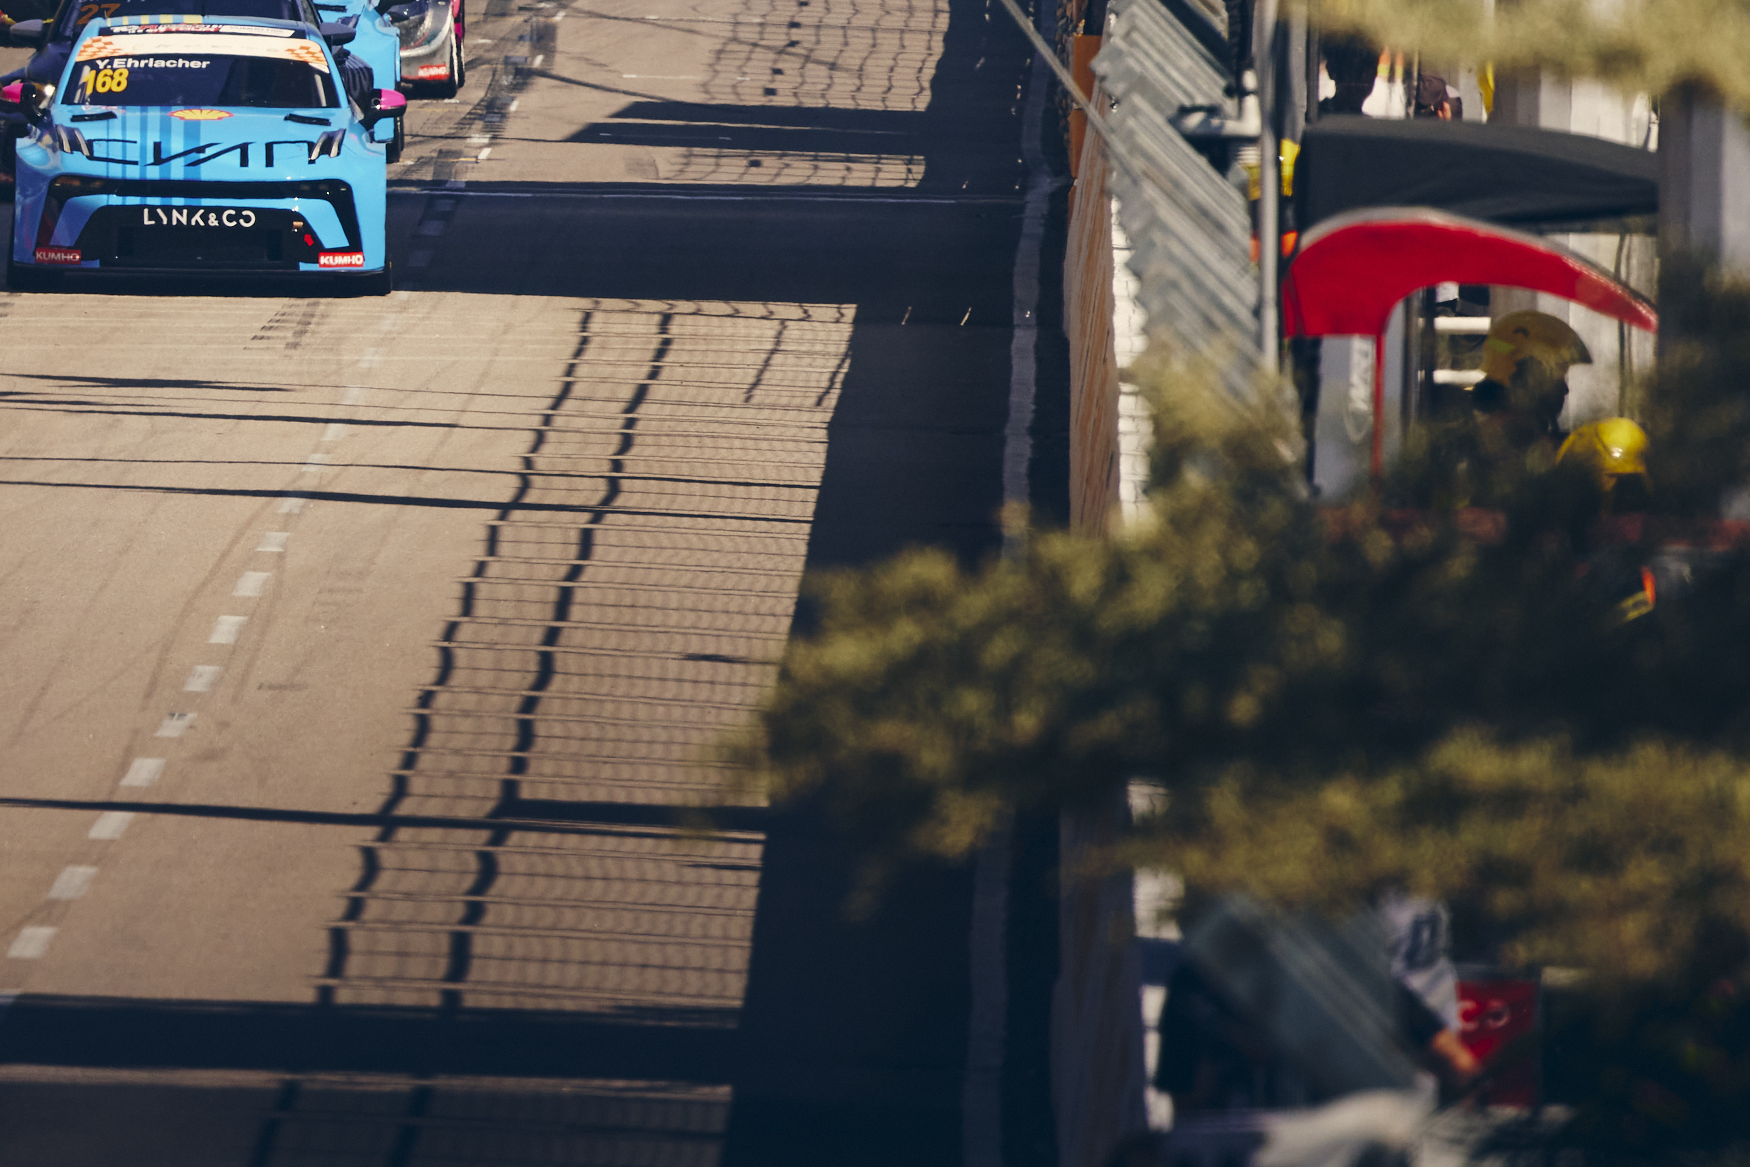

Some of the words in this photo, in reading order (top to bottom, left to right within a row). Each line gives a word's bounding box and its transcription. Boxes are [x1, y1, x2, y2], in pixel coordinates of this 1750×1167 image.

[75, 2, 121, 26] 27
[96, 58, 210, 70] Y.Ehrlacher
[84, 67, 129, 93] 168
[35, 250, 81, 263] KUMHO
[320, 253, 364, 266] KUMHO
